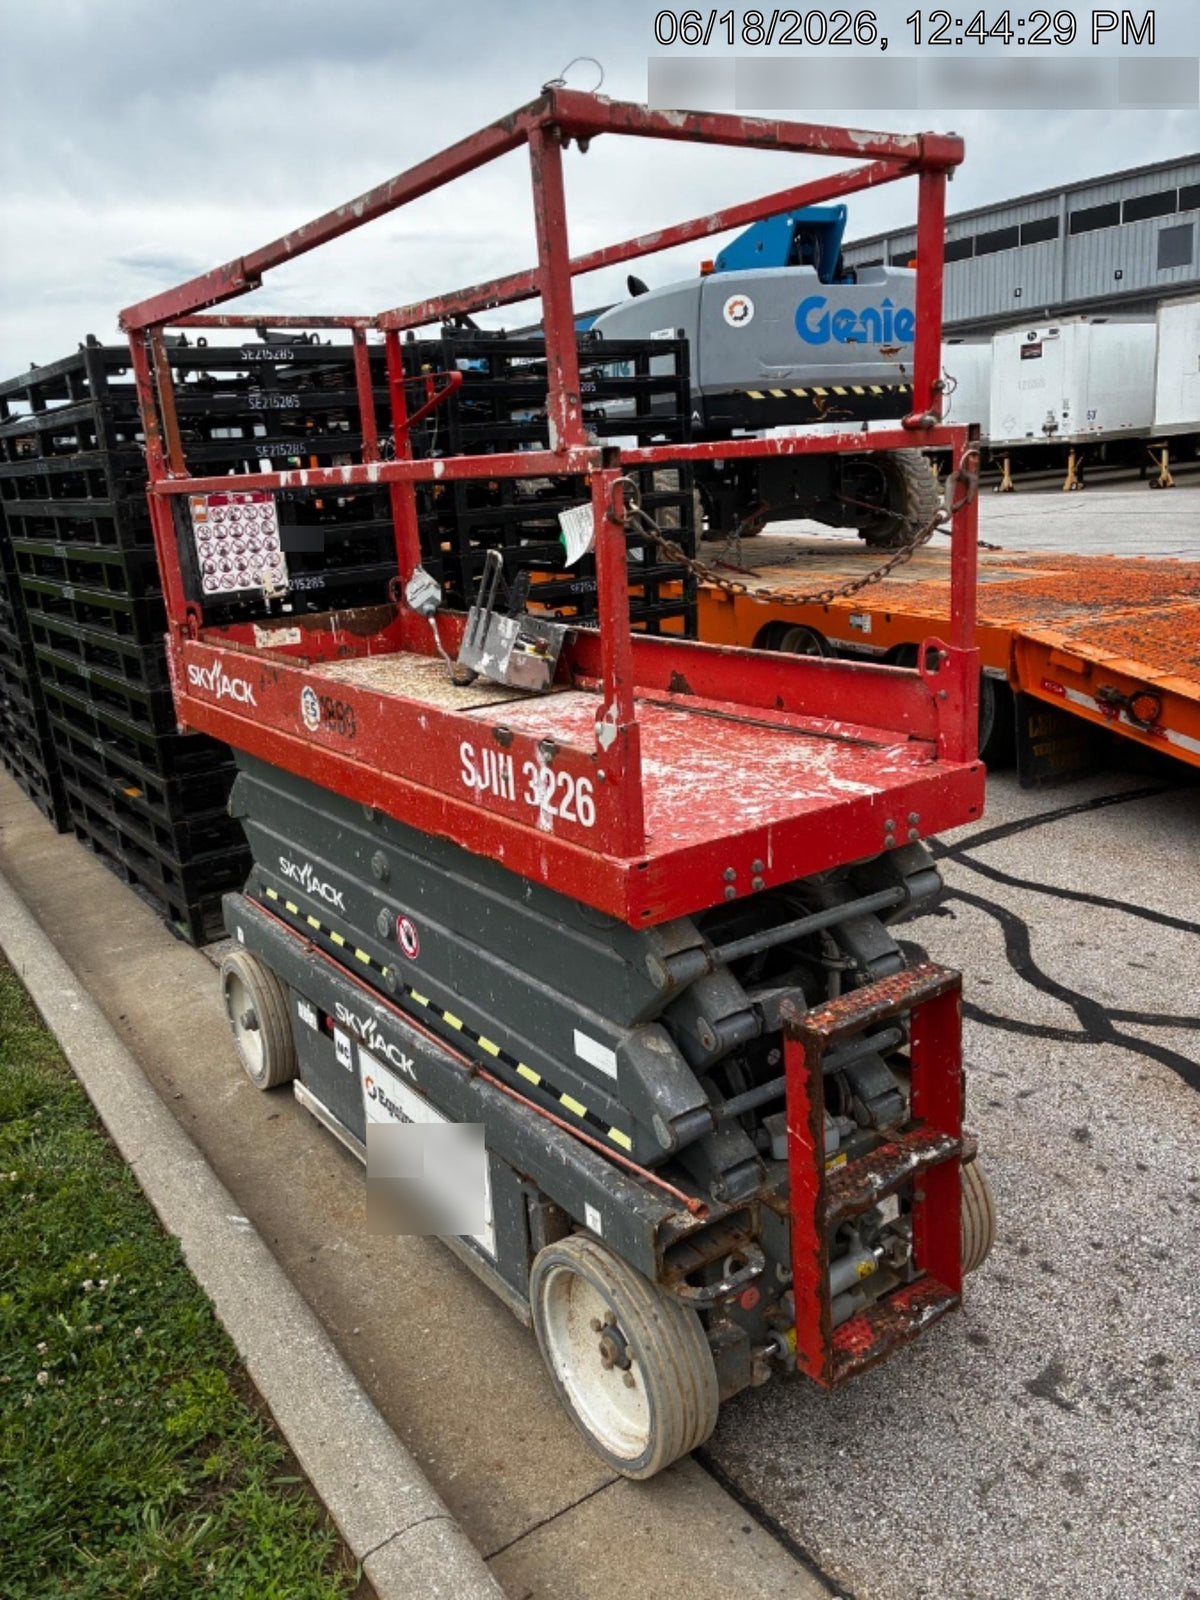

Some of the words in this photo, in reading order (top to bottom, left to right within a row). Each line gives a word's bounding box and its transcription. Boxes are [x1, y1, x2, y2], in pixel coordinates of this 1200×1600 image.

[795, 295, 915, 345] Genie
[187, 660, 258, 707] SKYJACK
[522, 760, 596, 828] 3226
[278, 856, 347, 912] SKYJACK
[335, 1002, 418, 1081] SKYJACK
